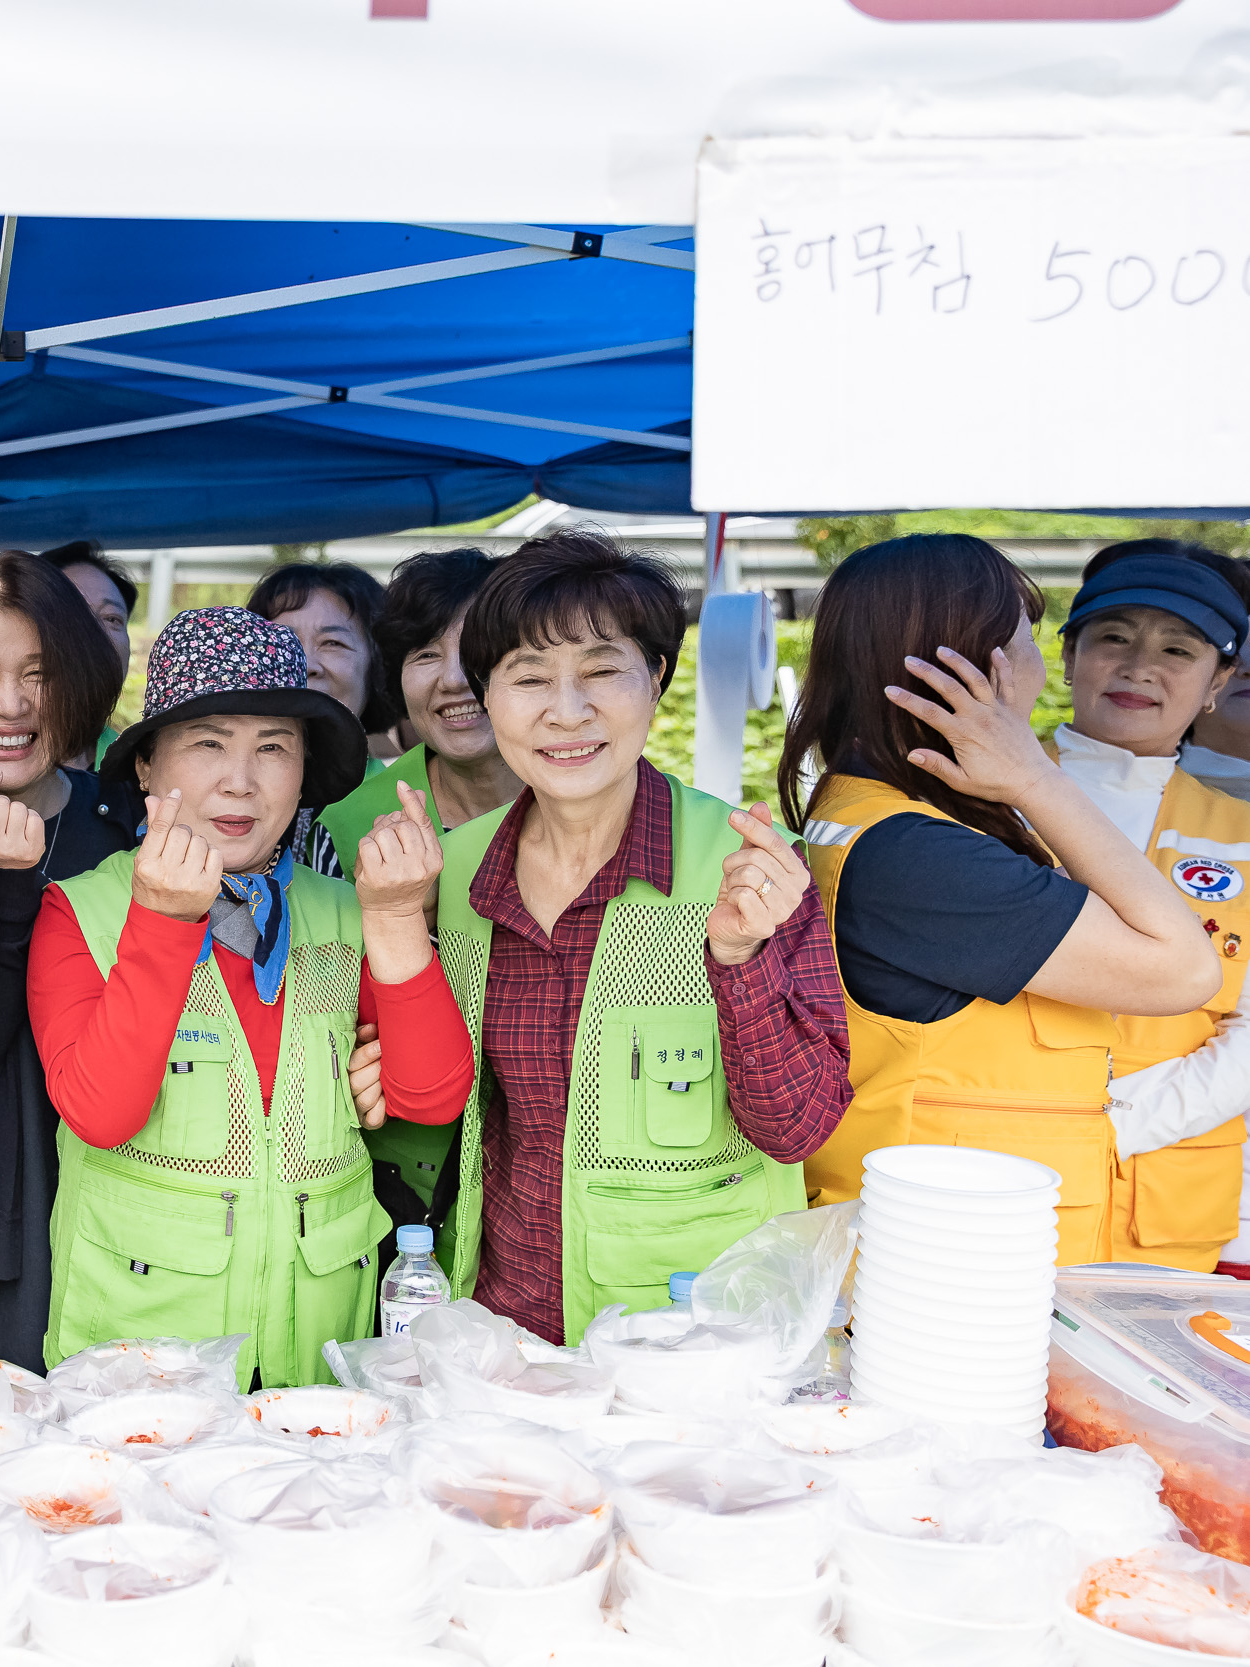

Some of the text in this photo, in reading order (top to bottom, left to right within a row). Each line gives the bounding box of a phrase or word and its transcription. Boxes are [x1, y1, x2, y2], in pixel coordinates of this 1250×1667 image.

[751, 218, 1250, 322] 홍어무침 500
[176, 1029, 221, 1045] 자원봉사센터
